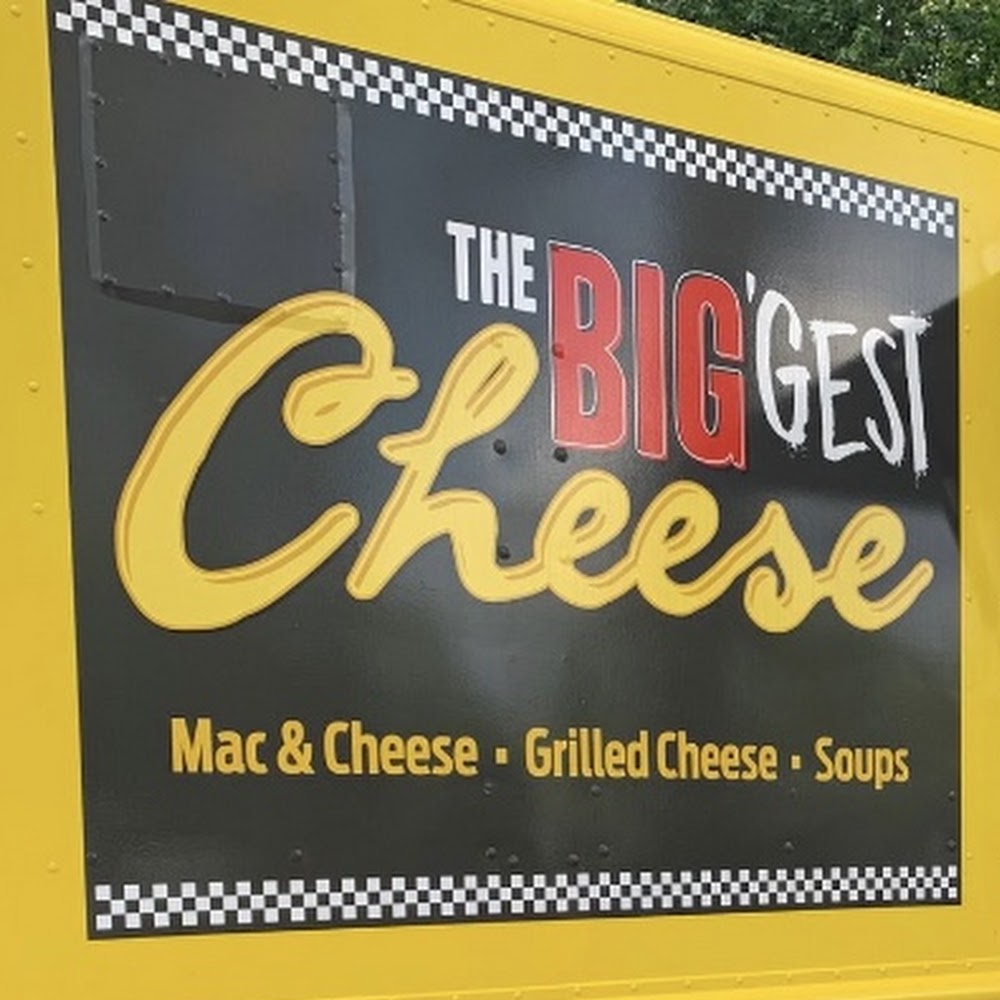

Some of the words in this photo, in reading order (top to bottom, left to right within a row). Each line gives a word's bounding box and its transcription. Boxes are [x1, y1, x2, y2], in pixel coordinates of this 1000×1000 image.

[446, 220, 538, 313] THE
[115, 291, 933, 632] Cheese
[171, 717, 269, 775] Mac
[277, 720, 315, 775] &
[323, 720, 479, 776] Cheese
[524, 727, 649, 779] Grilled
[656, 731, 778, 781] Cheese
[813, 736, 910, 790] Soups
